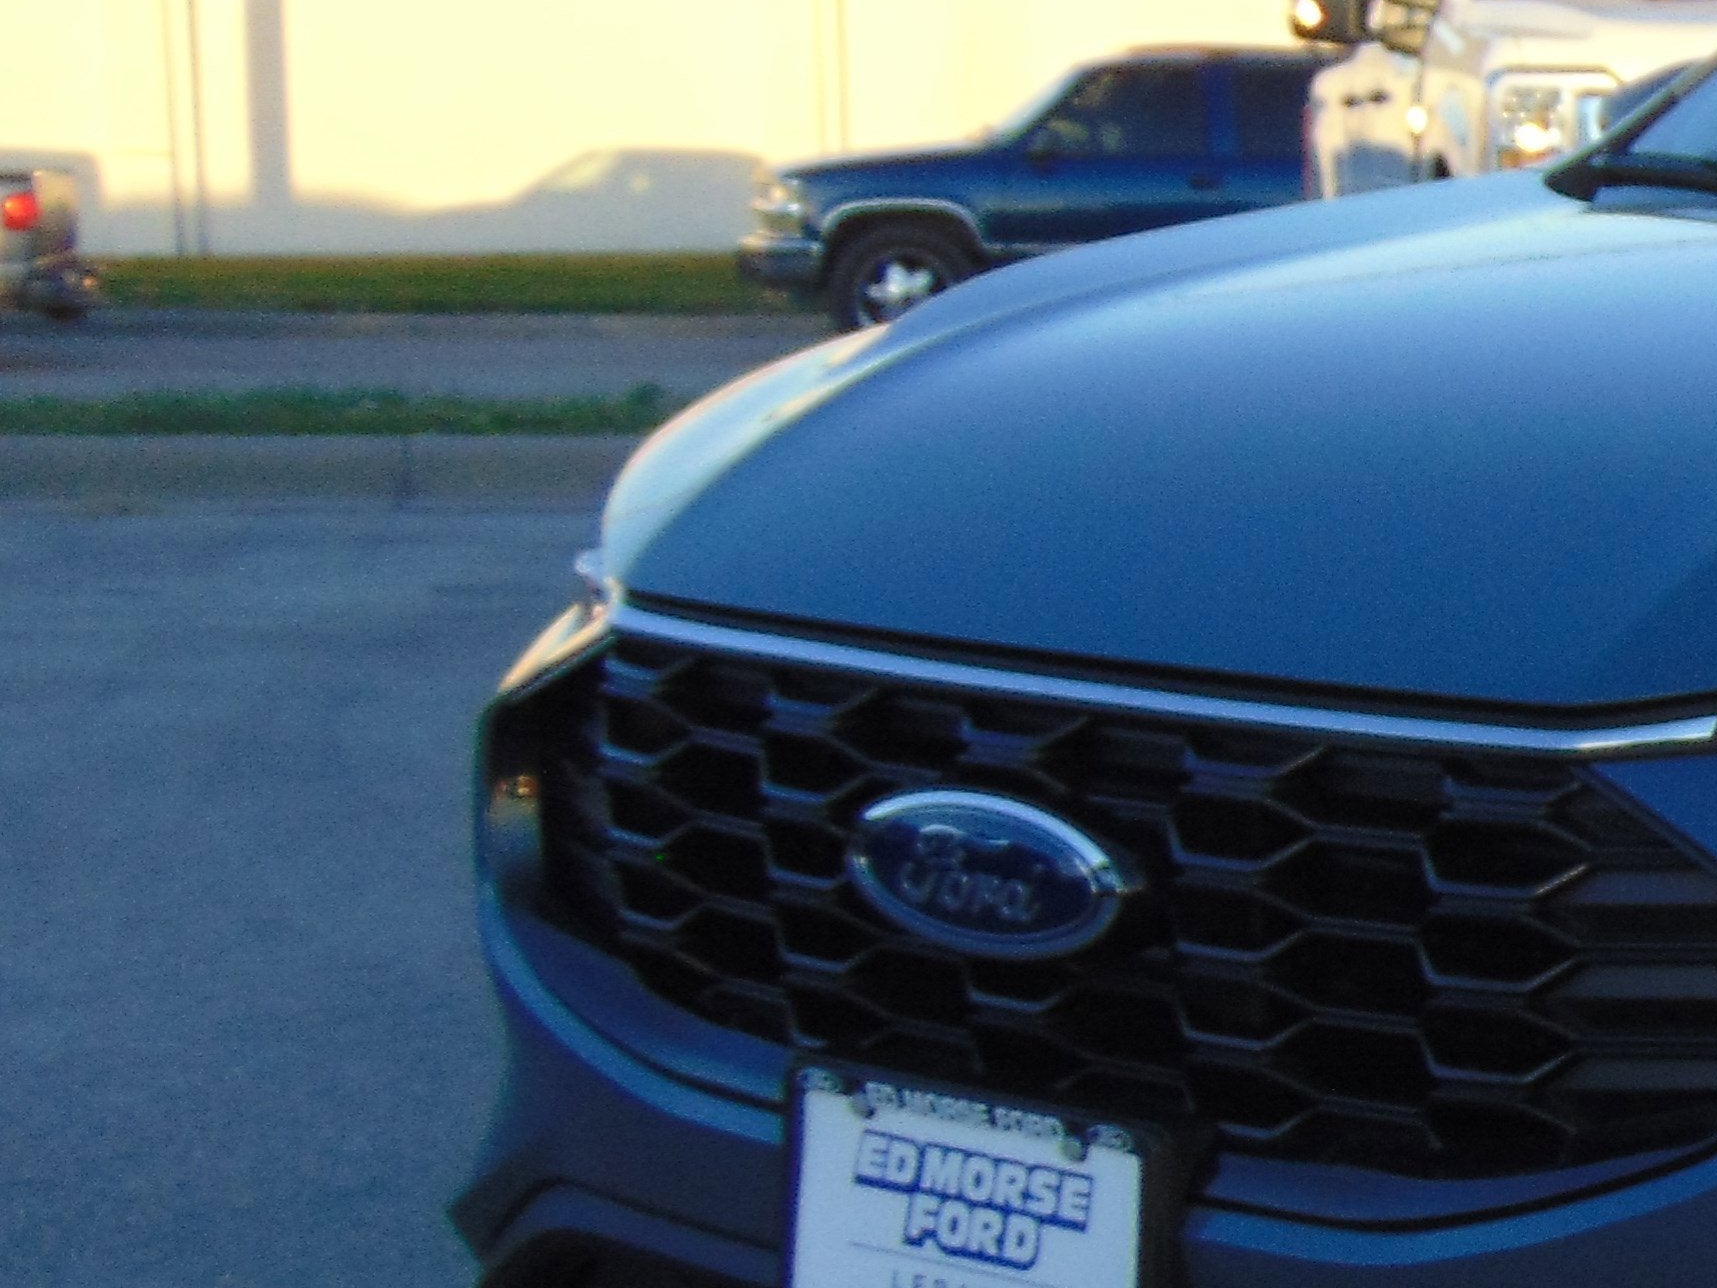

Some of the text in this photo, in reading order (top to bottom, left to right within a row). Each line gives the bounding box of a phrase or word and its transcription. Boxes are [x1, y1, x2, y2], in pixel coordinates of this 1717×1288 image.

[854, 1129, 1094, 1233] ED MORSE
[903, 1191, 1041, 1271] FORD
